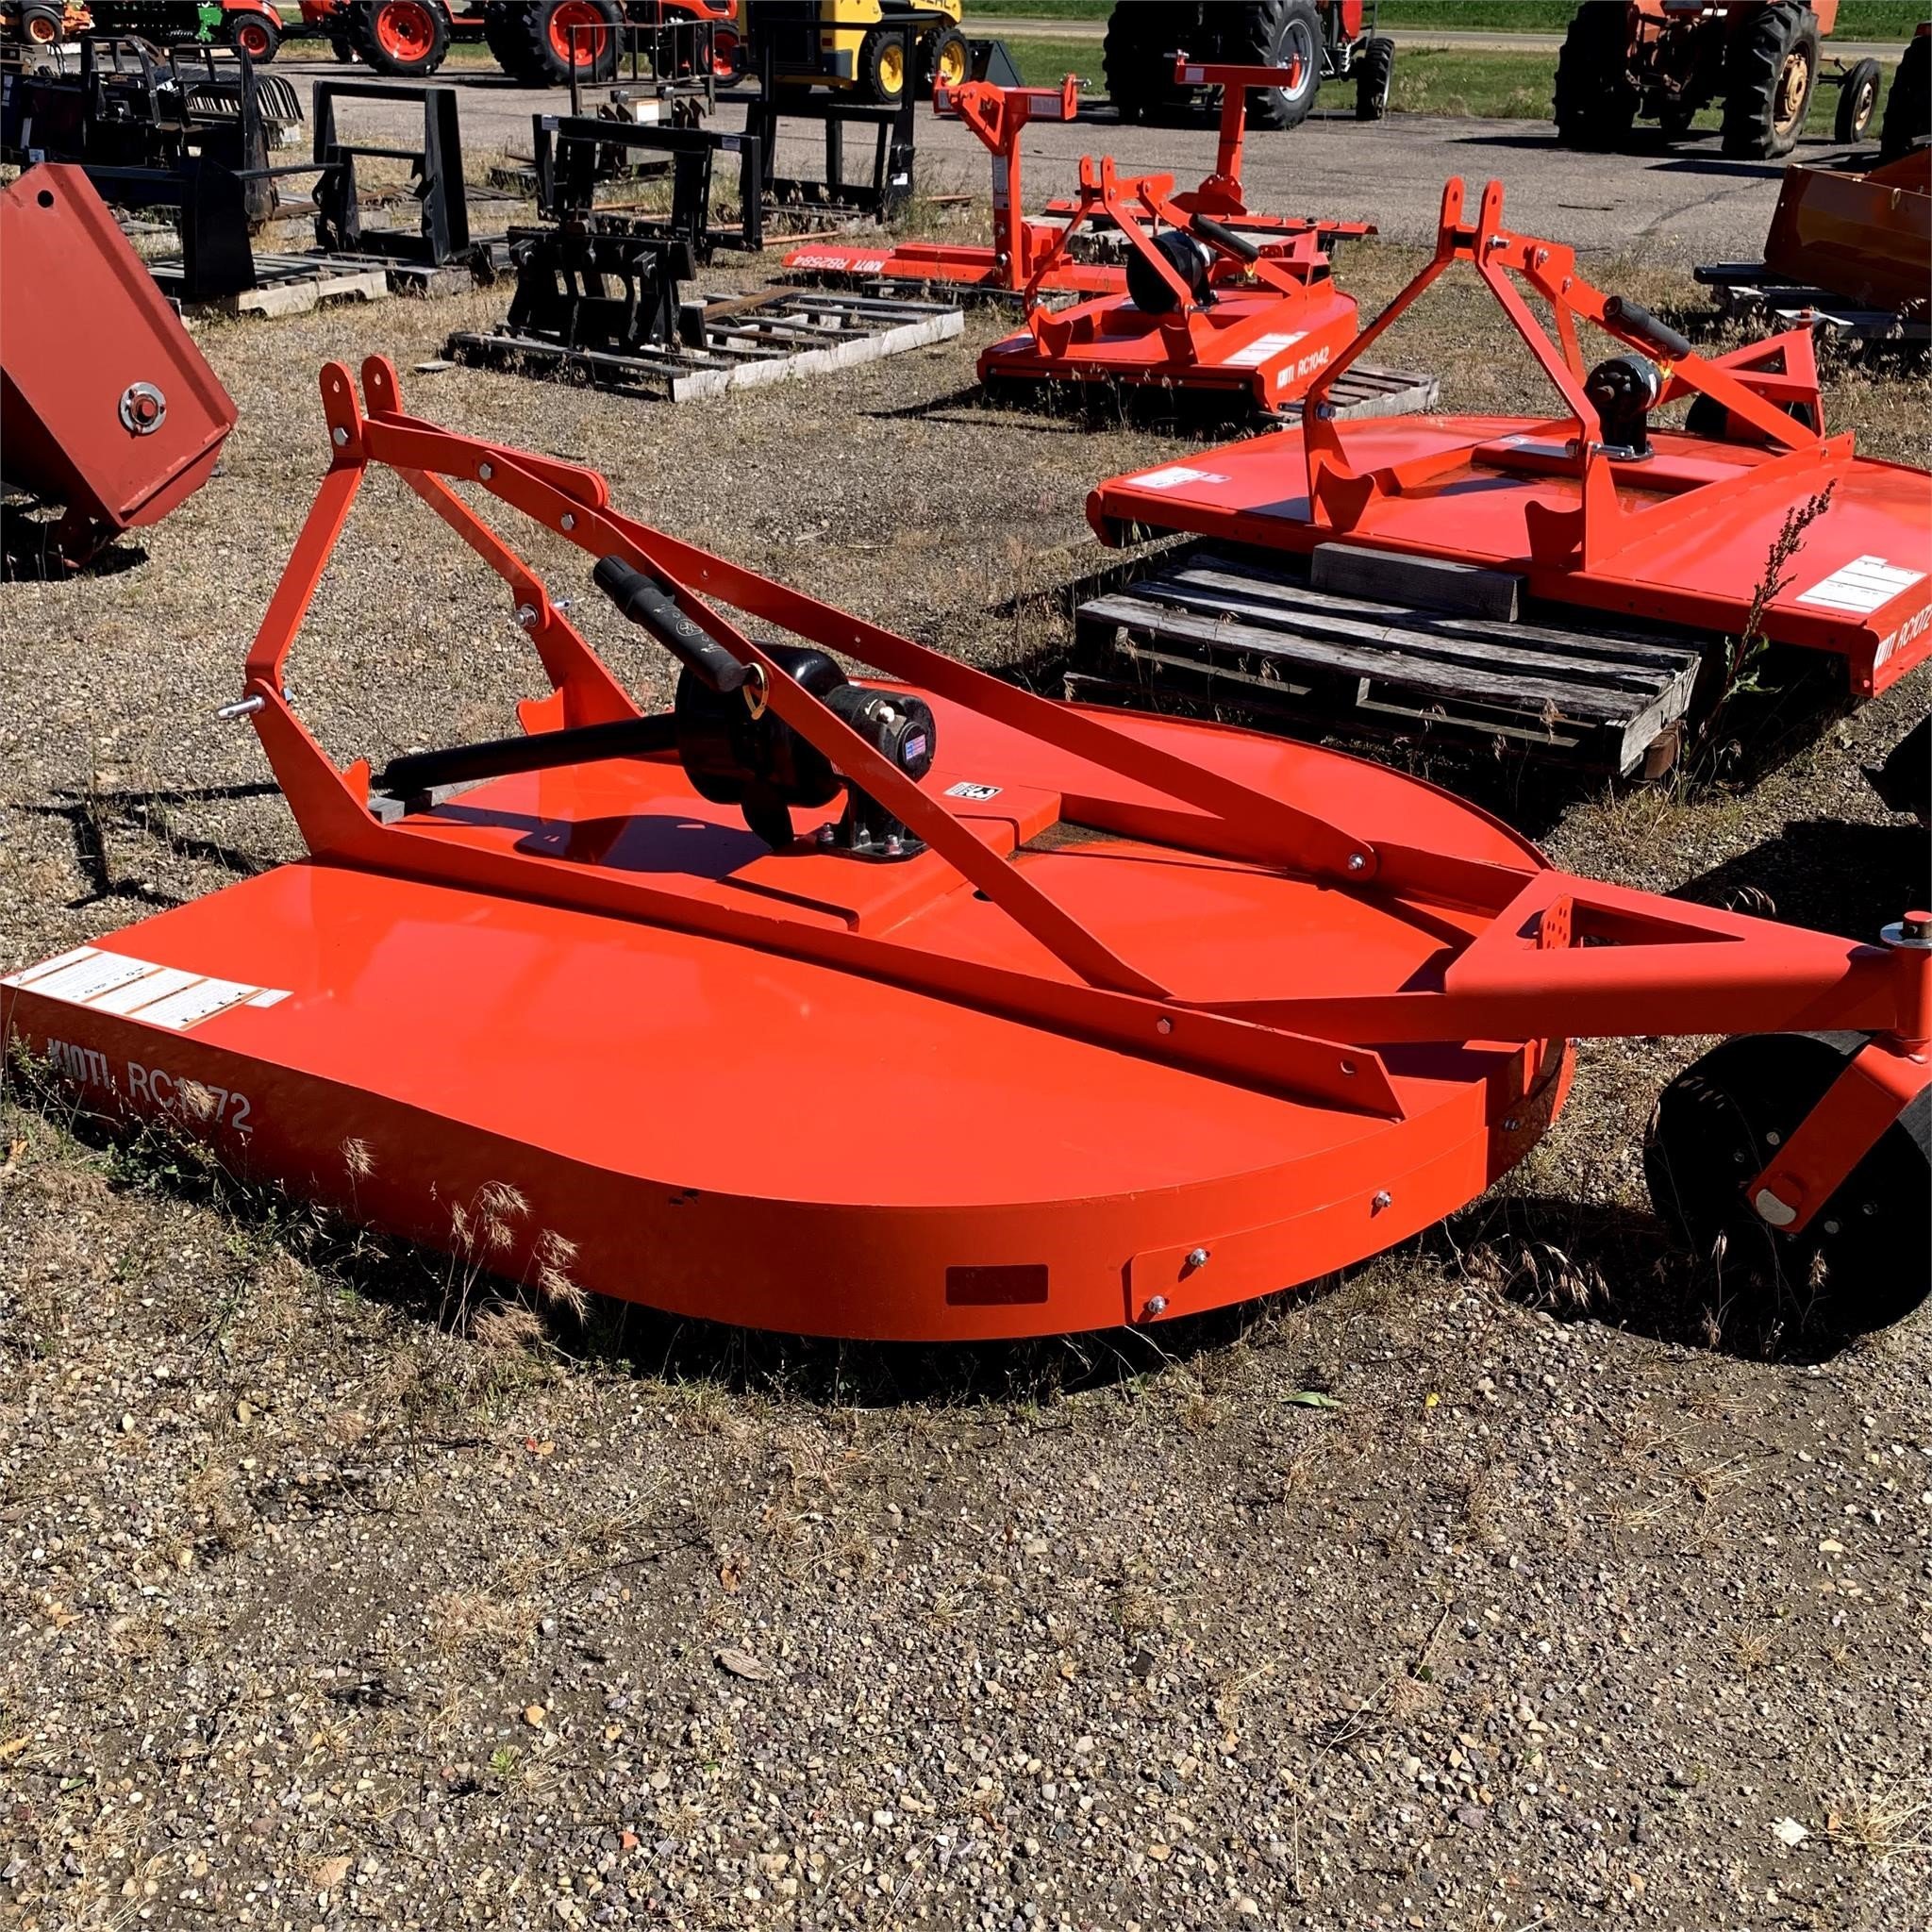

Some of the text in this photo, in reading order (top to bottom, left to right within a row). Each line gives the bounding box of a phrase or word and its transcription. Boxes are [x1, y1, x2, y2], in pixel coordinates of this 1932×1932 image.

[792, 256, 850, 269] RB2584
[1297, 345, 1329, 377] RC1042
[1895, 604, 1932, 653] RC1072
[47, 1038, 110, 1090] KIOTI
